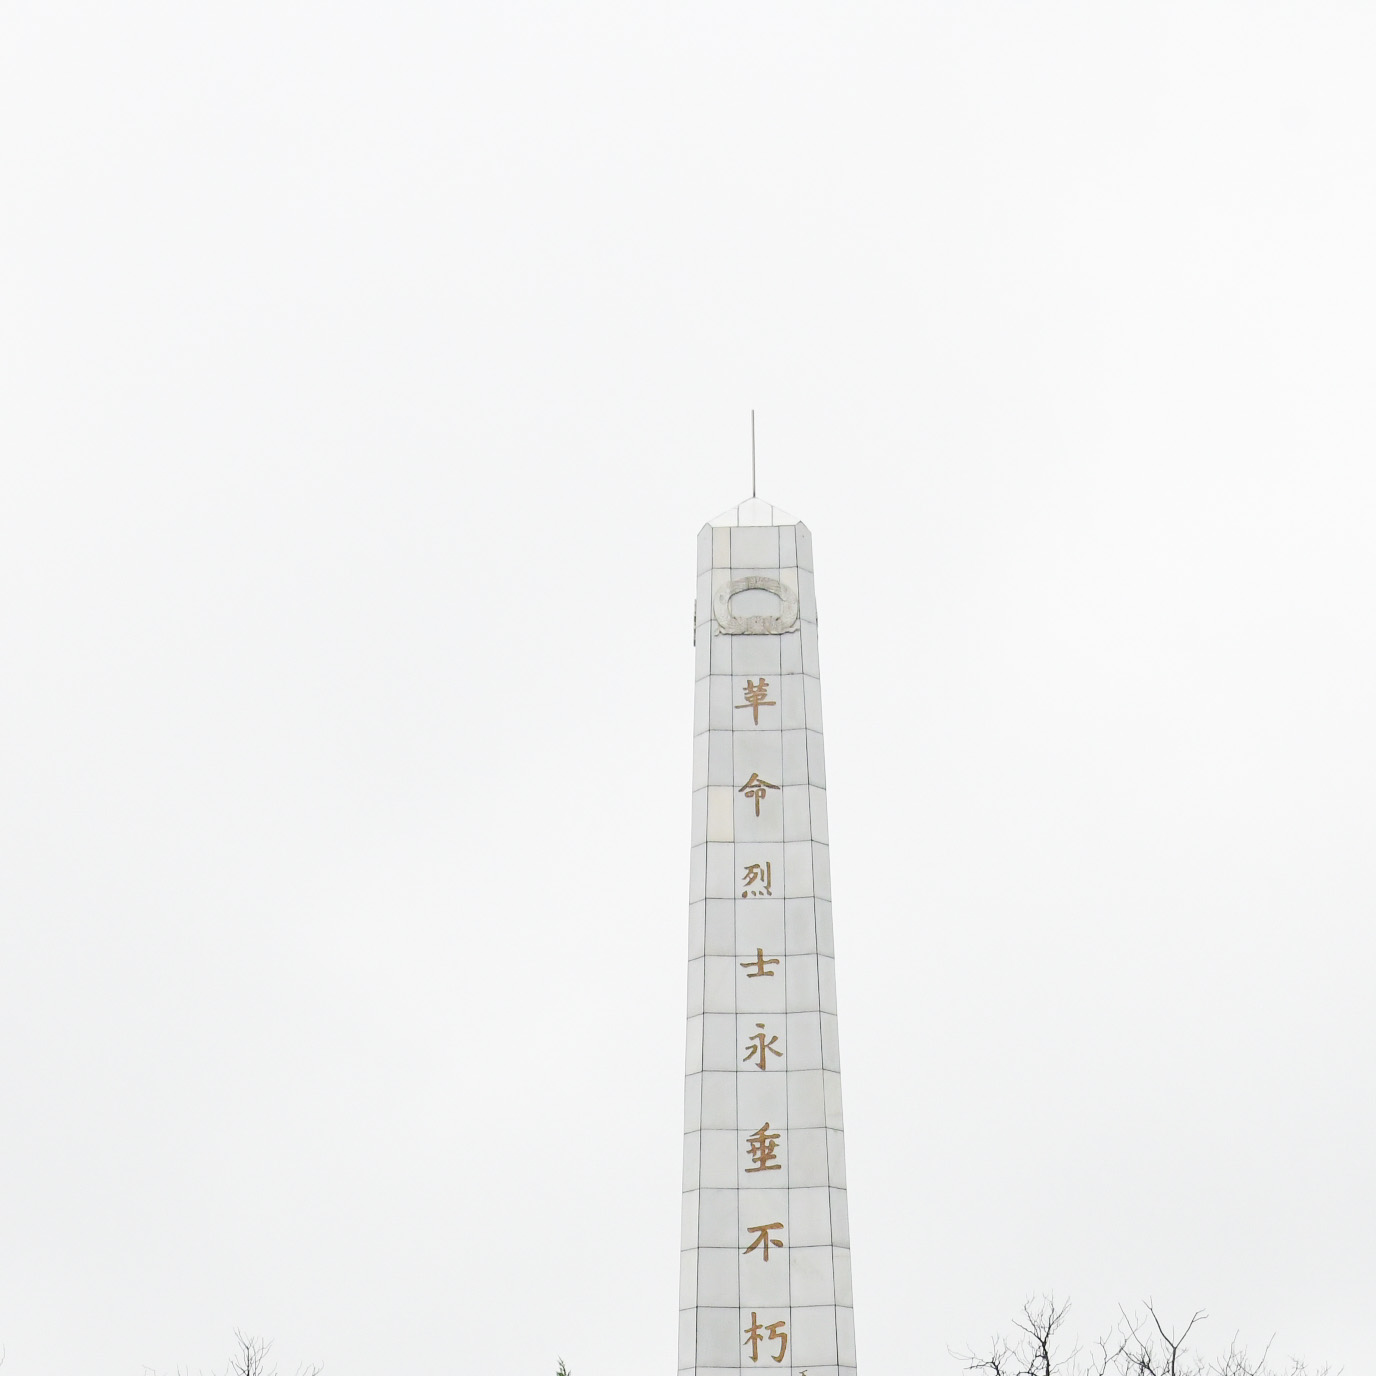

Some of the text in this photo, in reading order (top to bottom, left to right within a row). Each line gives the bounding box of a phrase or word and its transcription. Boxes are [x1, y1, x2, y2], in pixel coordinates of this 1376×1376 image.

[734, 677, 789, 1364] 革命烈士永垂不朽
